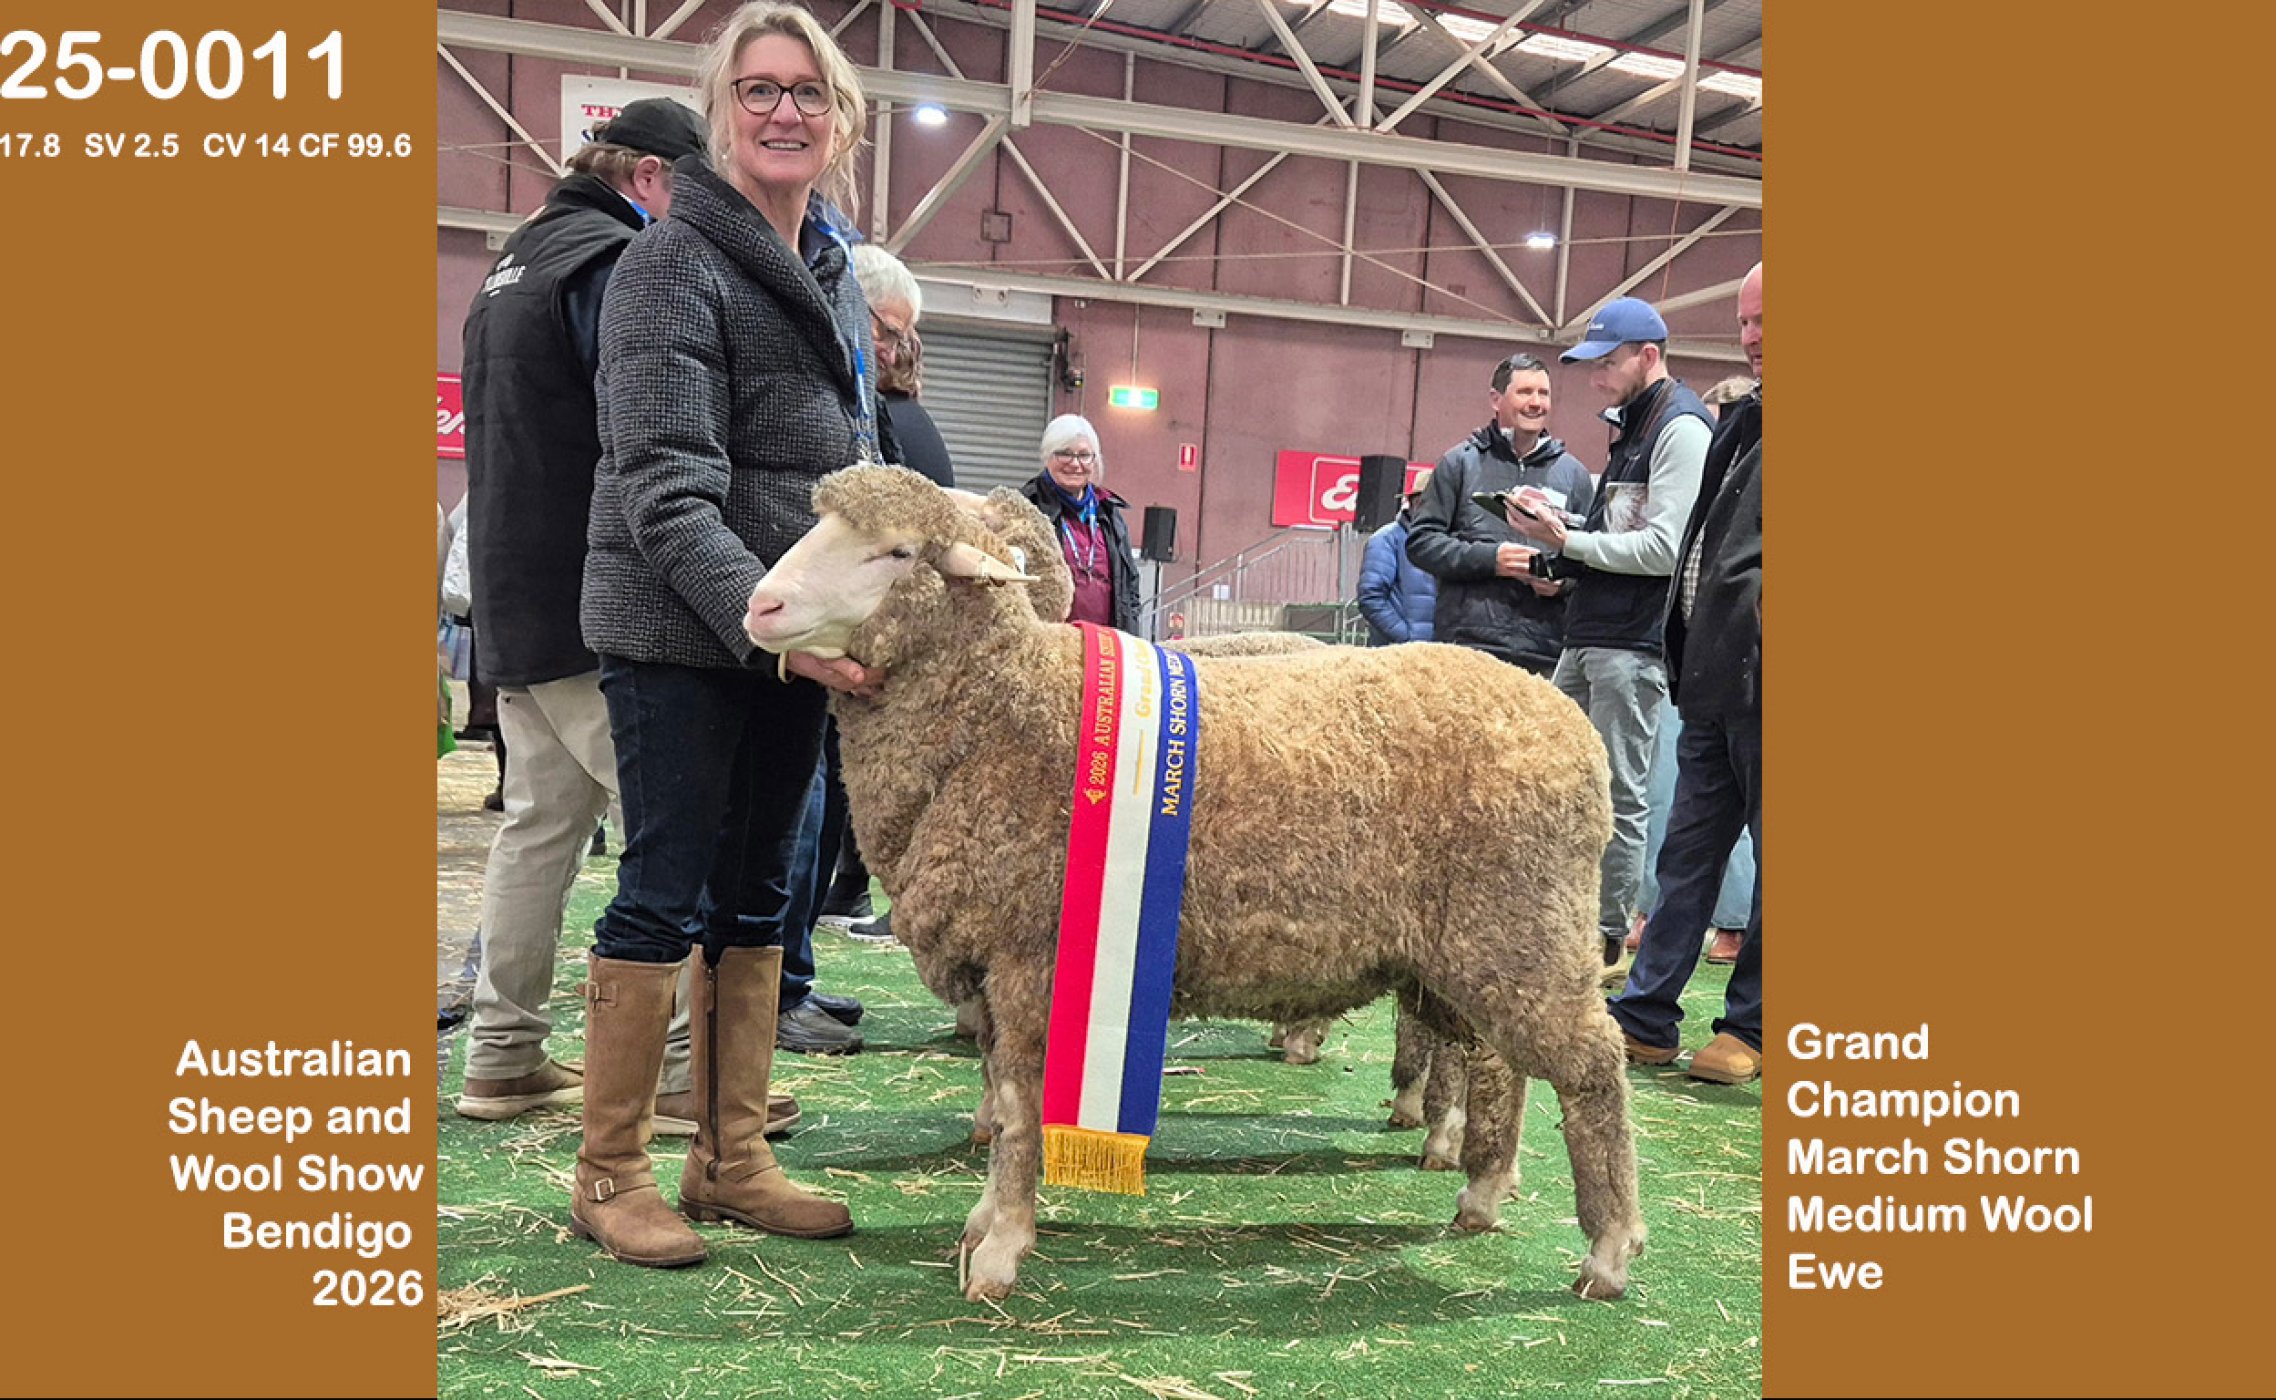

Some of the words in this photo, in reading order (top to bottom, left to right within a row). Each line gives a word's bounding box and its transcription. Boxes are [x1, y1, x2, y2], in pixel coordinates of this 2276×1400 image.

[1169, 677, 1188, 736] SHORN
[1089, 750, 1109, 786] 2026
[1161, 740, 1186, 817] MARCH
